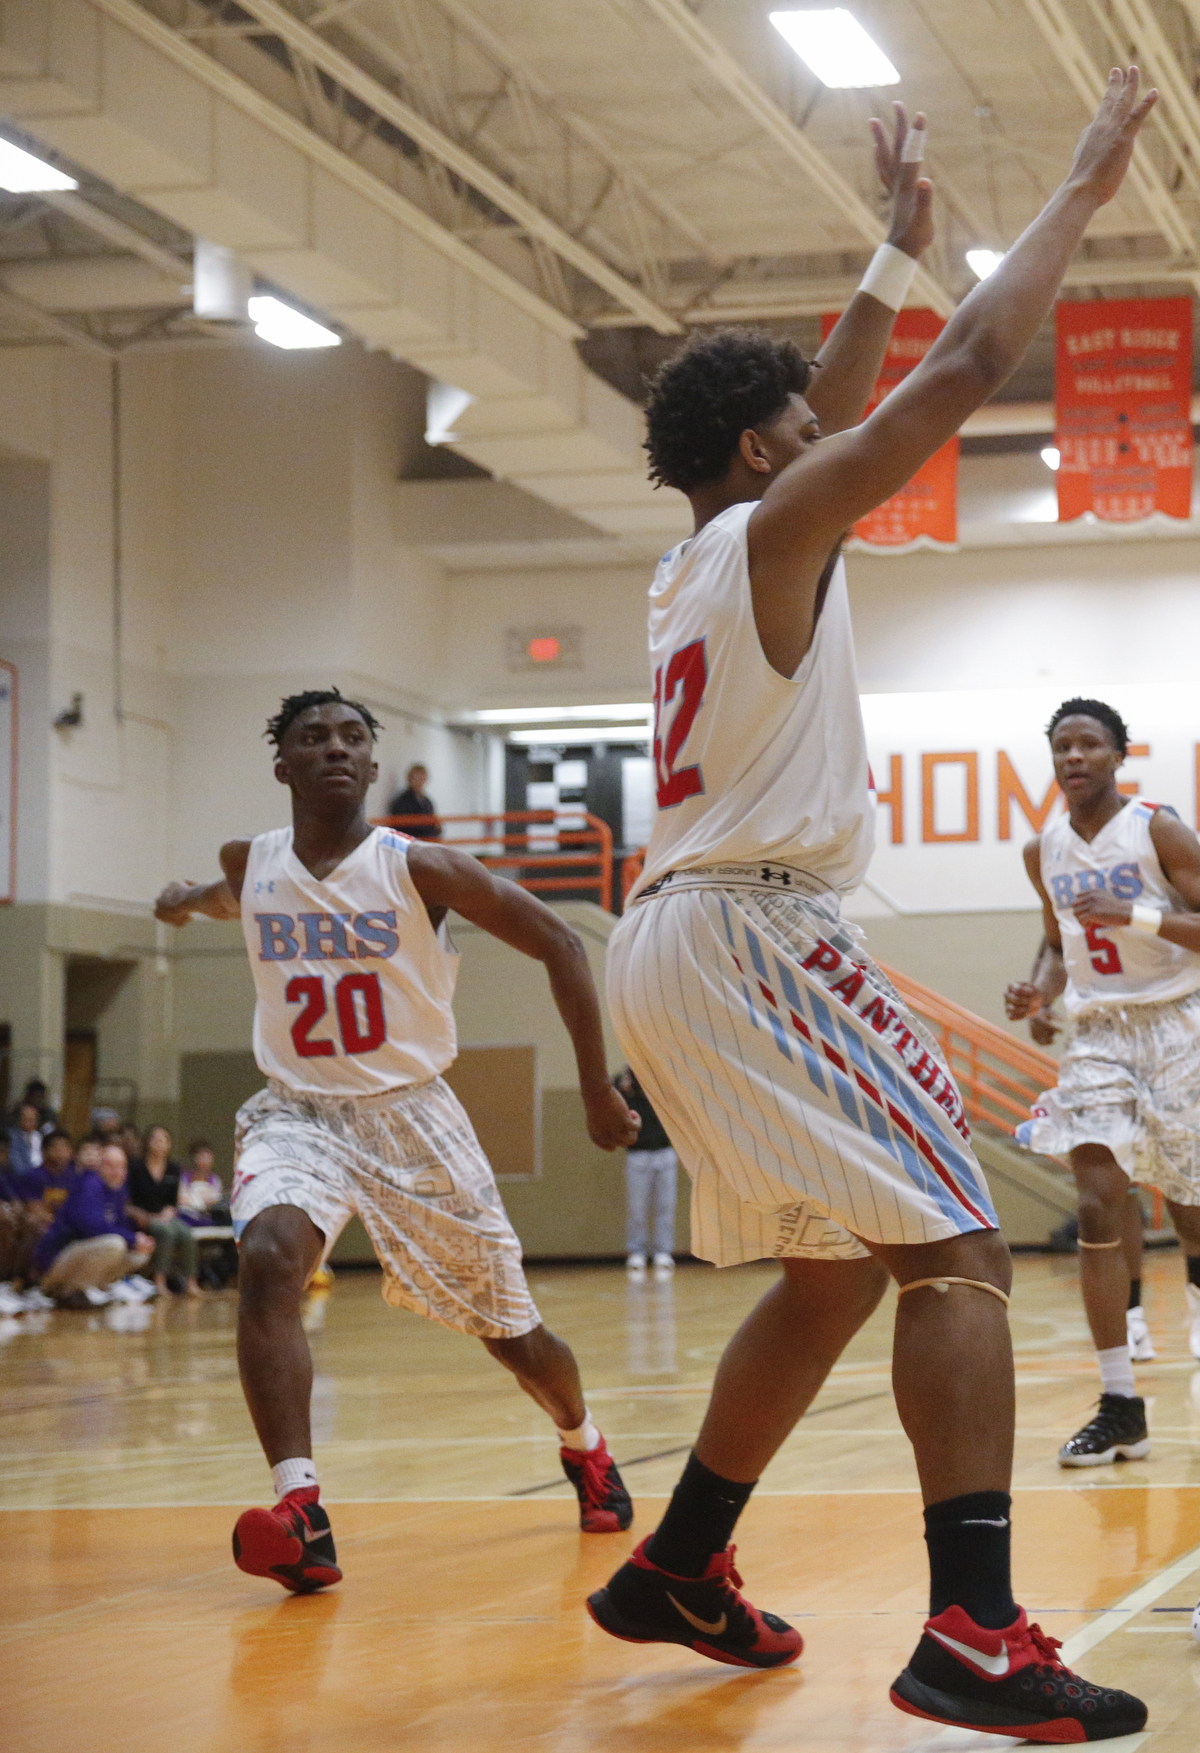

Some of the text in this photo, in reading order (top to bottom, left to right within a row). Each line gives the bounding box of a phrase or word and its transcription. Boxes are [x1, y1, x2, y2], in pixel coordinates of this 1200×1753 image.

[254, 909, 400, 961] BHS
[1085, 920, 1124, 976] 5
[285, 970, 388, 1058] 20
